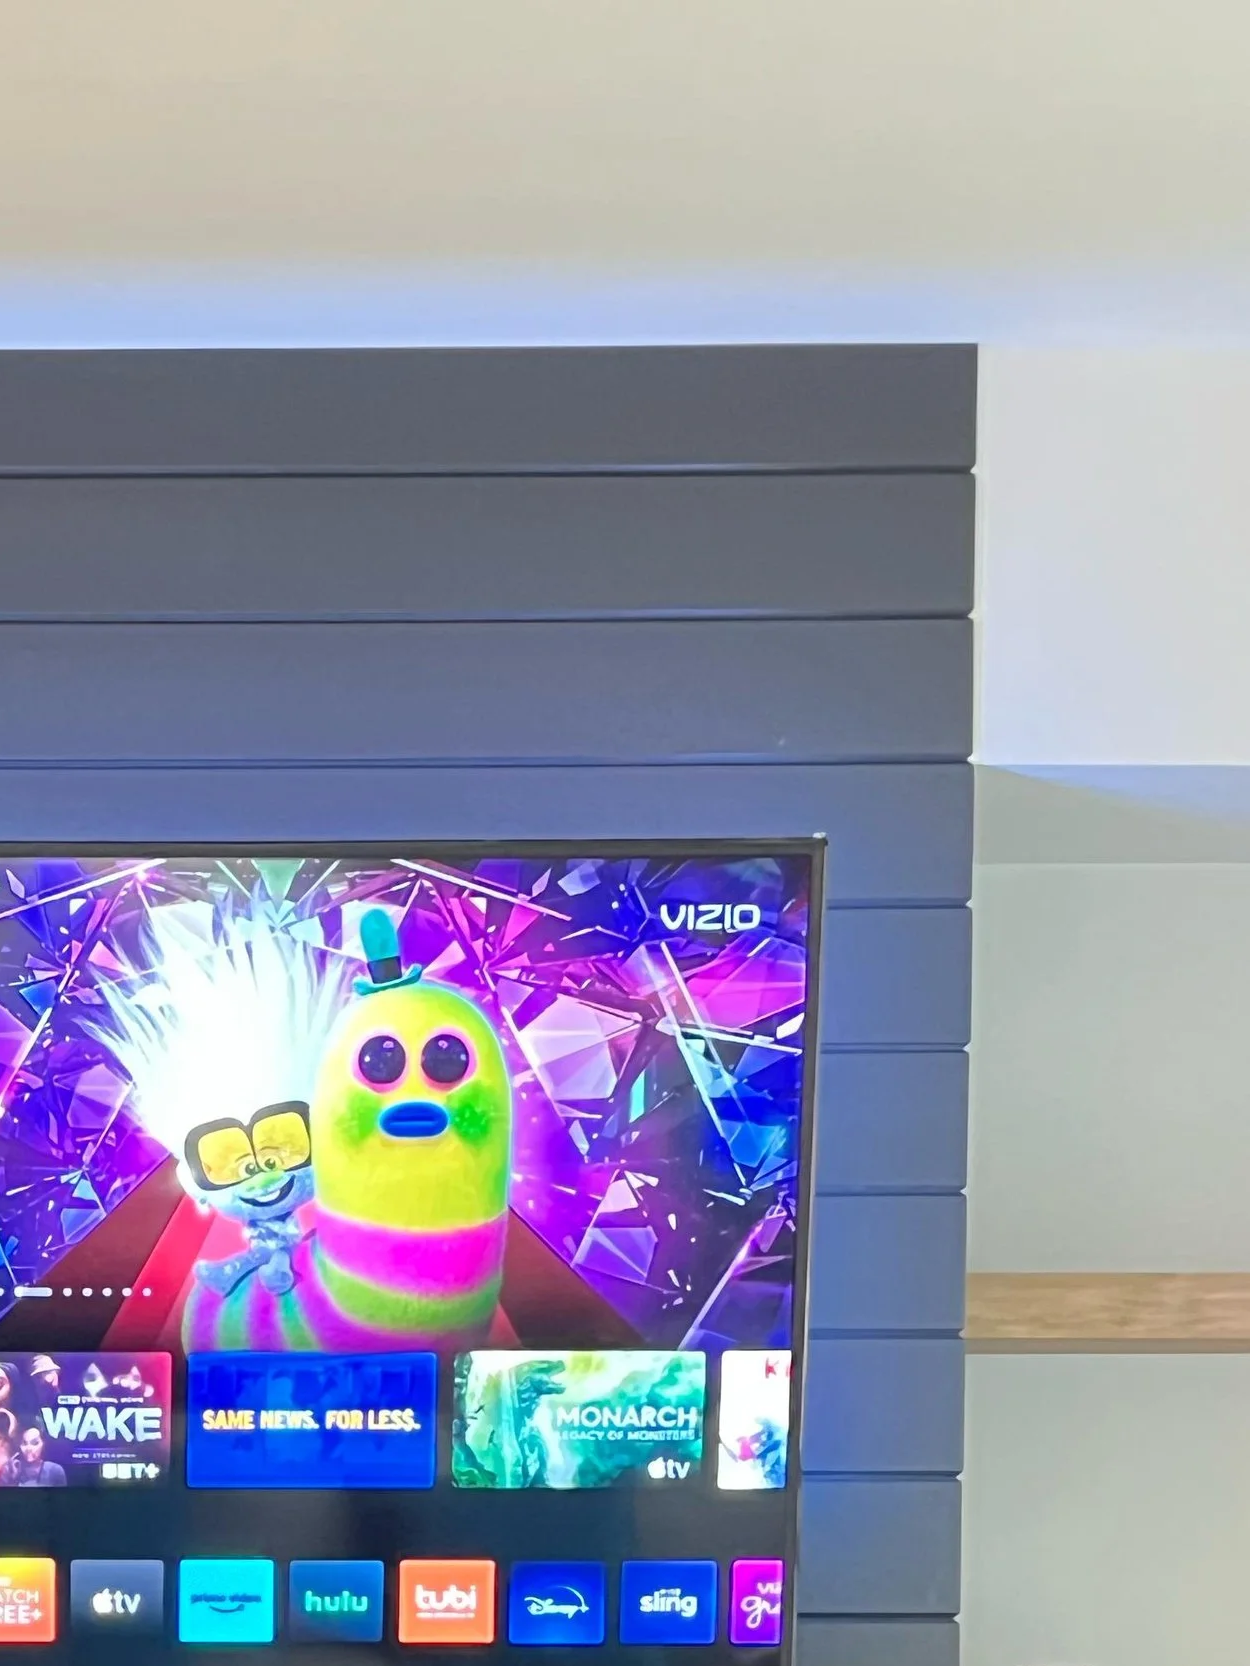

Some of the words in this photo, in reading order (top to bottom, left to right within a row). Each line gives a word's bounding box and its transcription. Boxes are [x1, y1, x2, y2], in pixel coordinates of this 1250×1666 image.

[660, 904, 761, 931] VIZIO
[41, 1406, 162, 1442] WAKE
[202, 1410, 255, 1430] SAME
[260, 1410, 320, 1430] NEWS.
[325, 1410, 364, 1430] FOR
[556, 1406, 698, 1429] MONARCH
[559, 1430, 604, 1440] LEGACY
[607, 1430, 624, 1440] OF
[305, 1591, 368, 1612] hulu
[415, 1584, 477, 1611] tubi
[639, 1590, 698, 1617] sling
